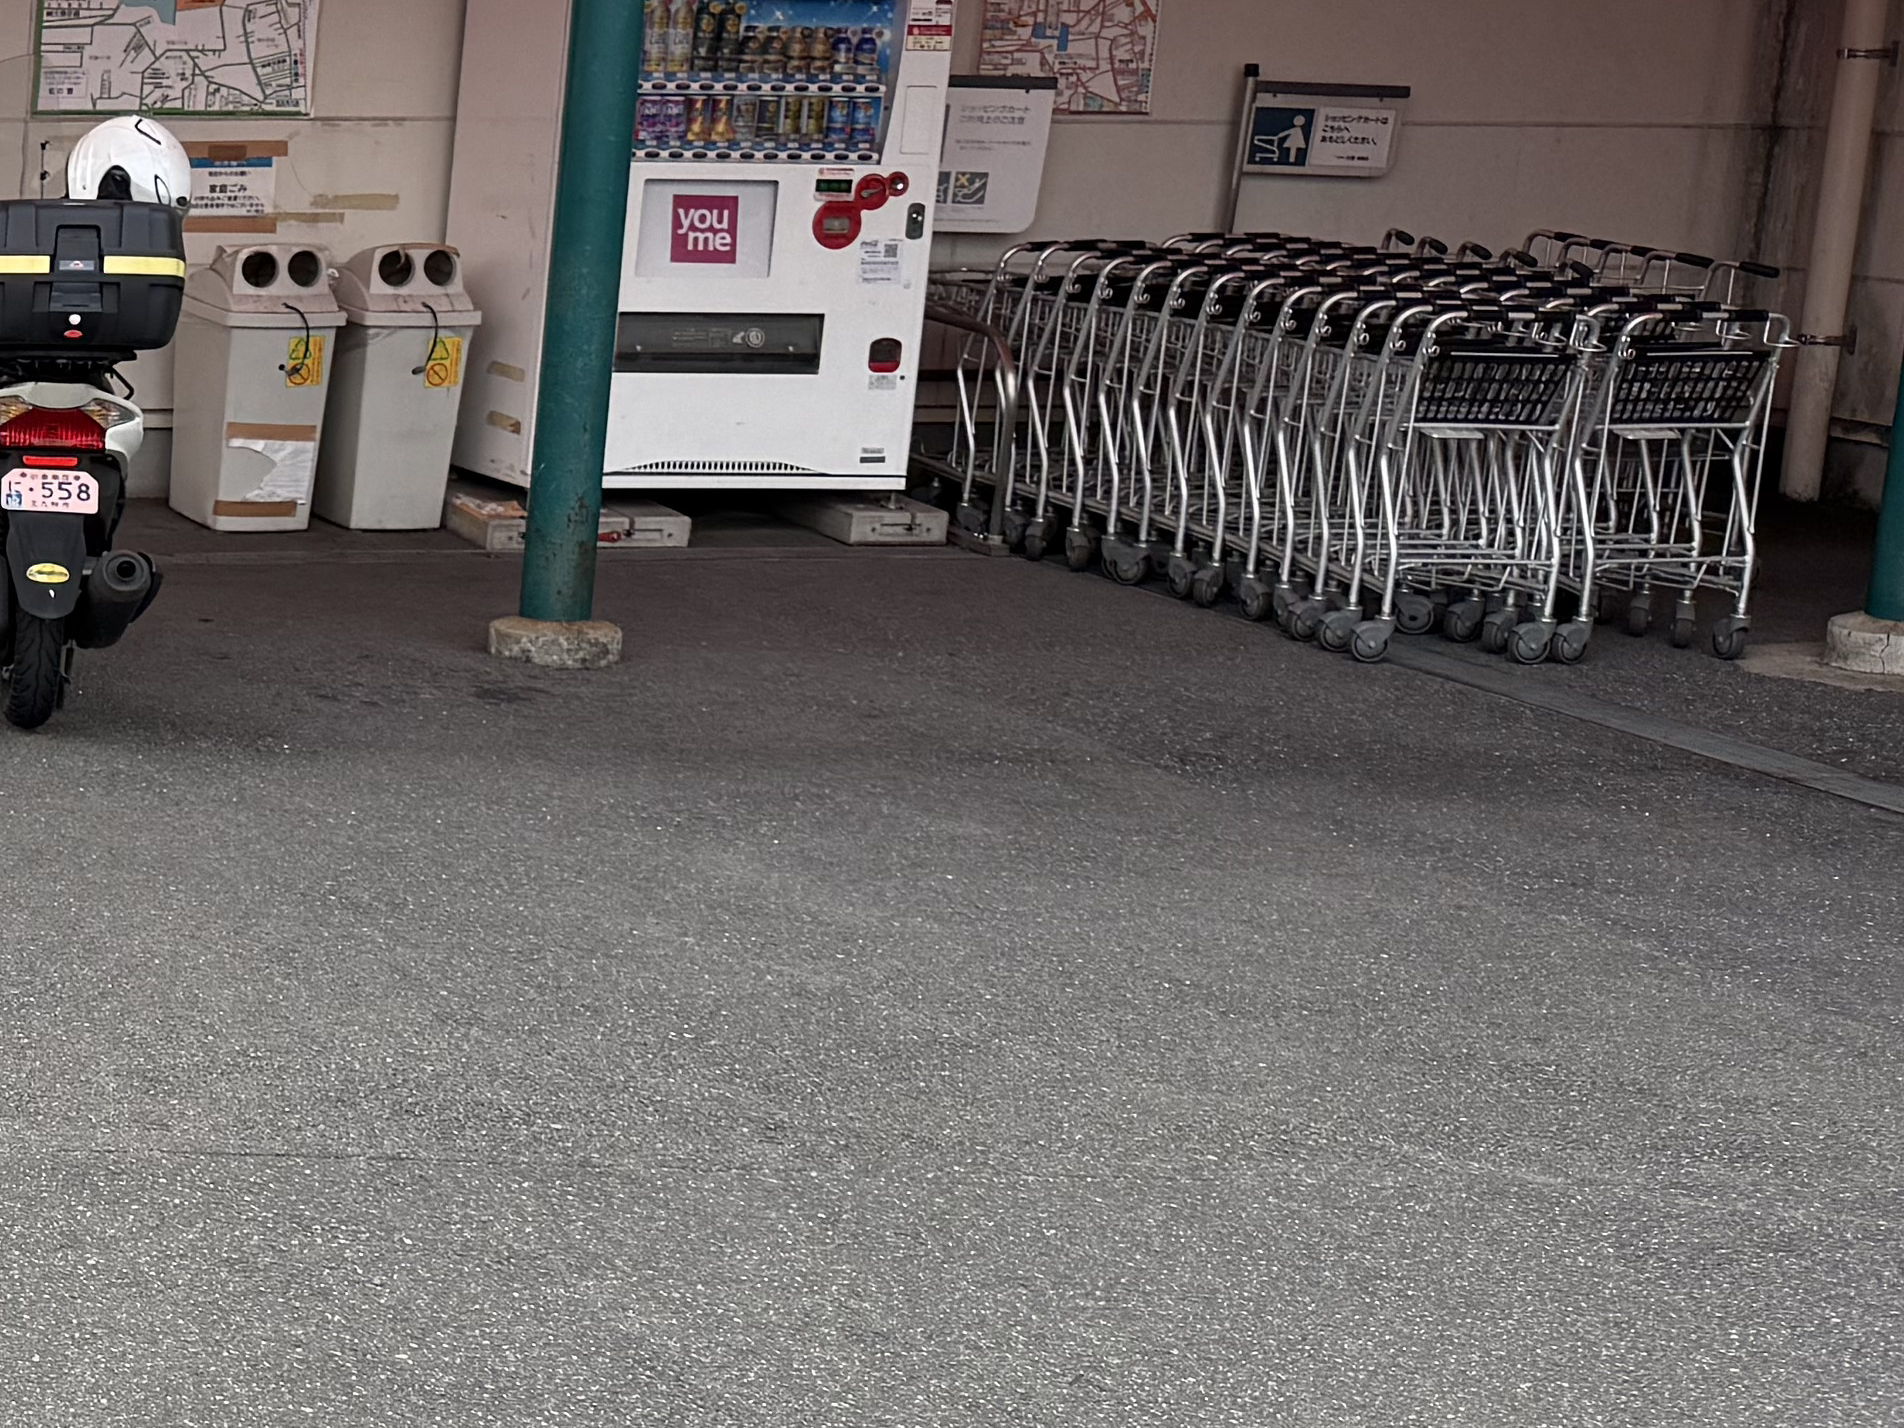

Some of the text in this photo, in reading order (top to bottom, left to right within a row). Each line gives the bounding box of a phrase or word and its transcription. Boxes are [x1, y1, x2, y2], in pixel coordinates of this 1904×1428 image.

[209, 183, 248, 194] 家庭ごみ
[676, 208, 729, 234] you
[687, 231, 732, 251] me
